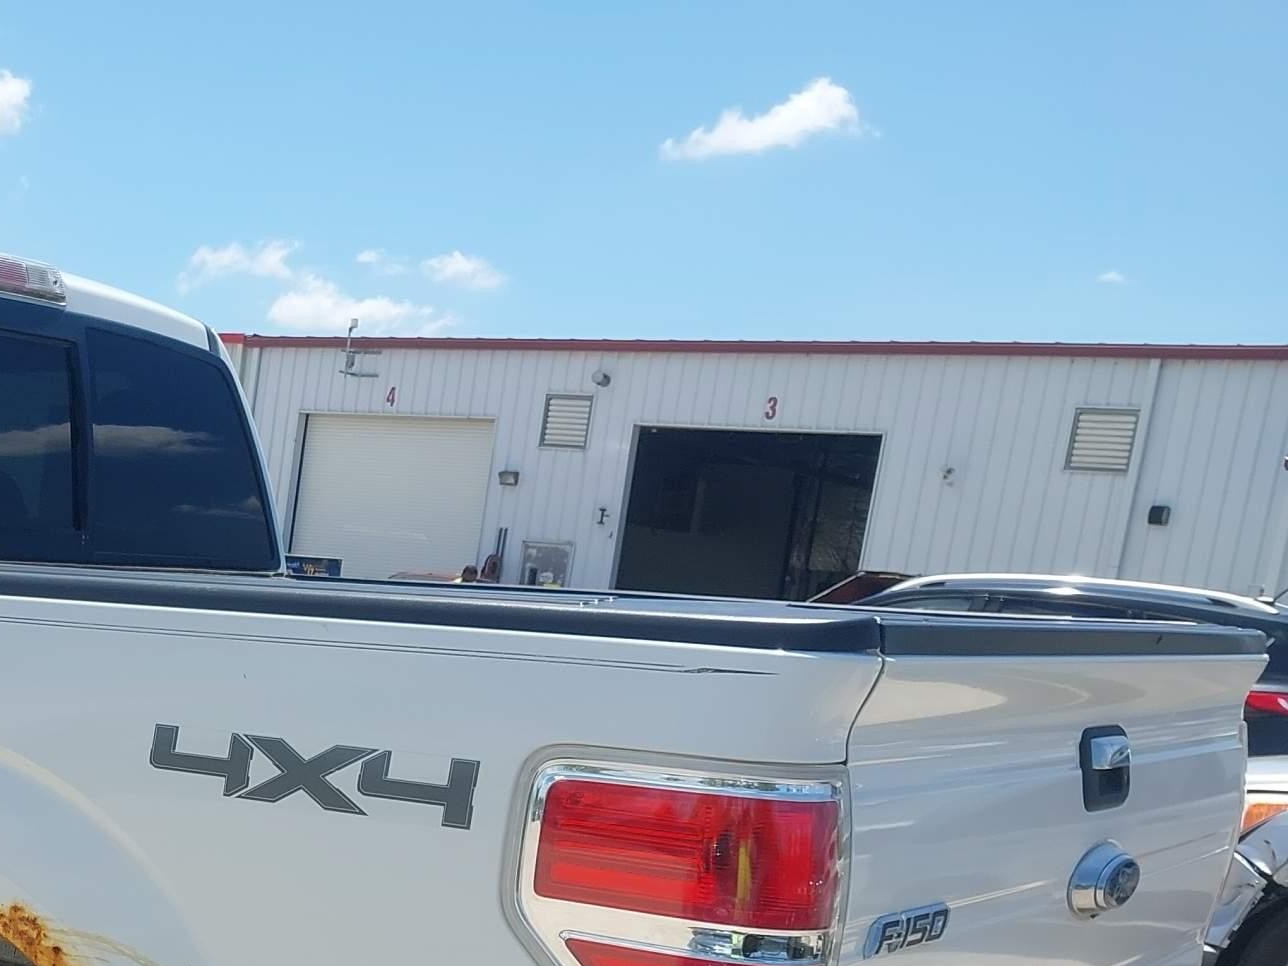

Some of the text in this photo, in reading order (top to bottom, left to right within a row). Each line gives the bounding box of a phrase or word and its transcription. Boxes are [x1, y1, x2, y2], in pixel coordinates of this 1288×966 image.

[386, 386, 396, 407] 4
[764, 396, 778, 420] 3
[874, 907, 949, 955] F-150
